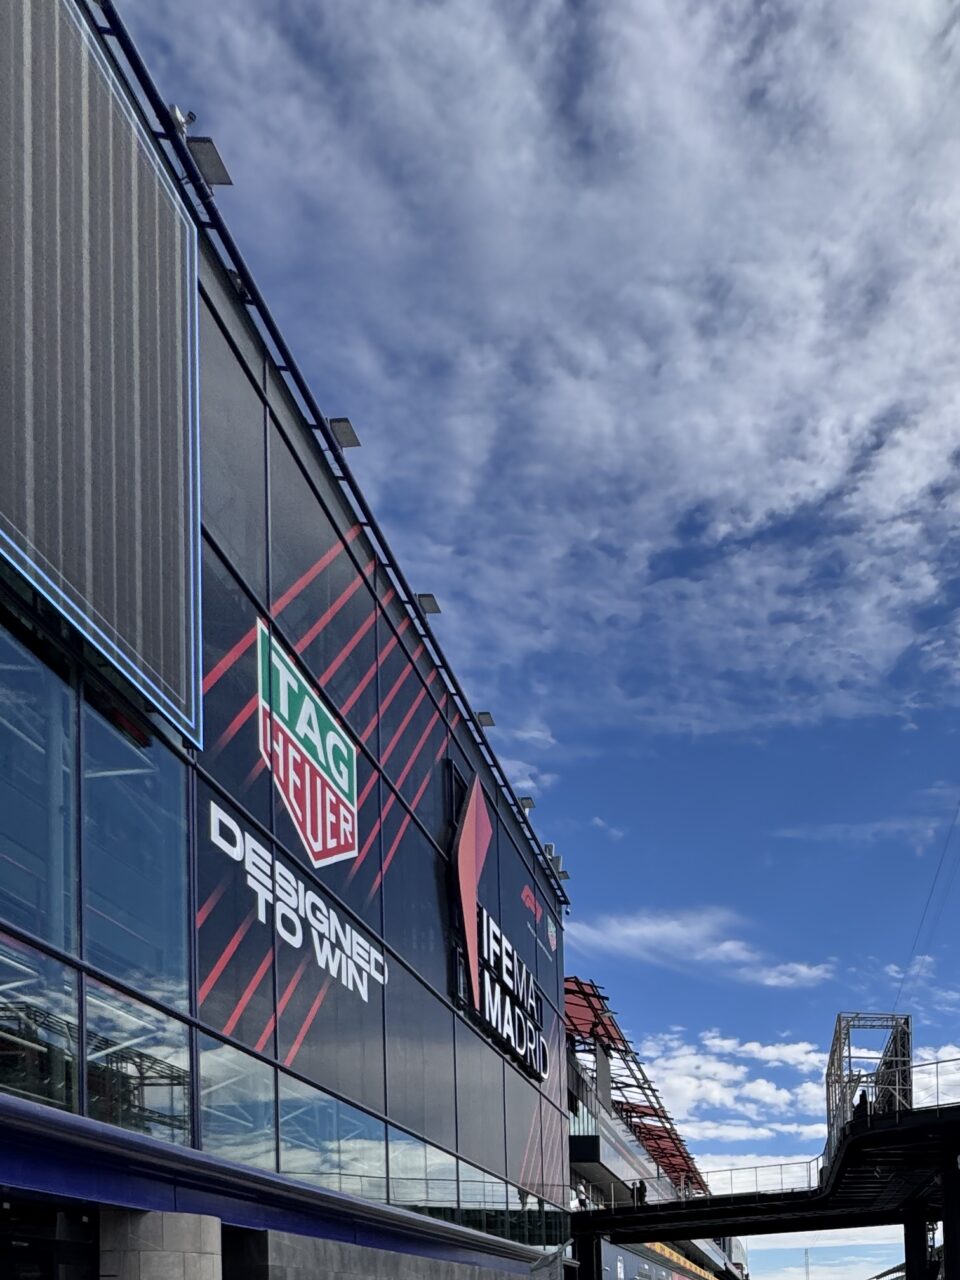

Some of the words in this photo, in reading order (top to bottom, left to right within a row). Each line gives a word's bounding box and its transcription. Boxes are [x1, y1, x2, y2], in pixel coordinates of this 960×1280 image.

[266, 717, 352, 852] HEUER
[271, 650, 349, 794] TAG
[210, 800, 388, 985] DESIGNED
[247, 873, 303, 949] TO
[311, 926, 369, 1003] WIN
[483, 907, 538, 1021] IFEMA
[484, 968, 549, 1080] MADRID
